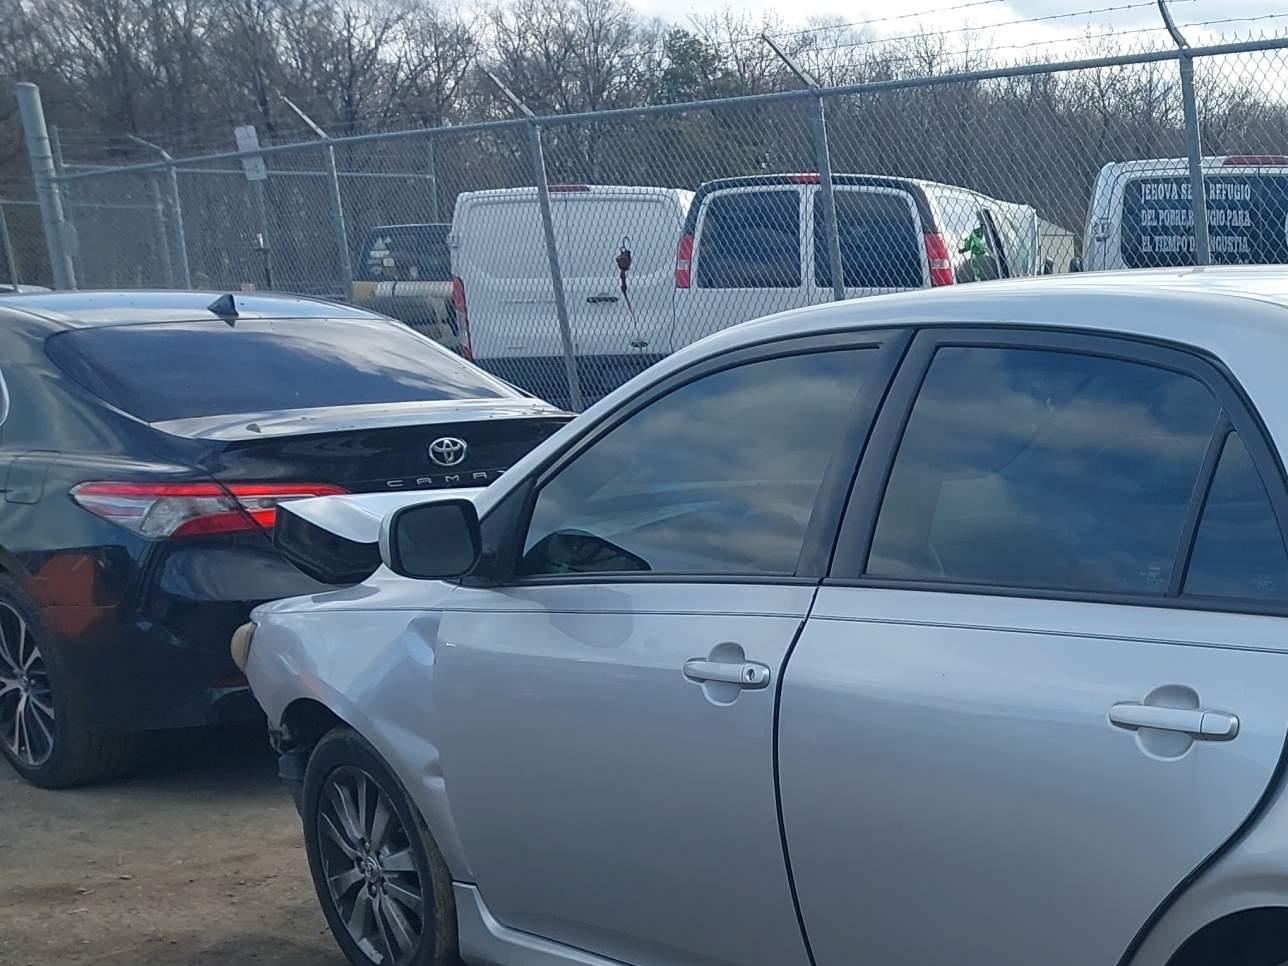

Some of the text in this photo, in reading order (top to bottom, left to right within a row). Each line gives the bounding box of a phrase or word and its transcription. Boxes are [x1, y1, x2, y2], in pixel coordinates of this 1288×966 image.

[1141, 183, 1178, 204] JEHOVA
[1209, 183, 1251, 200] REFUGIO
[1141, 209, 1157, 226] DEL
[1142, 236, 1152, 252] EL
[1154, 236, 1188, 252] TIEMPO
[386, 470, 505, 487] CAMR
